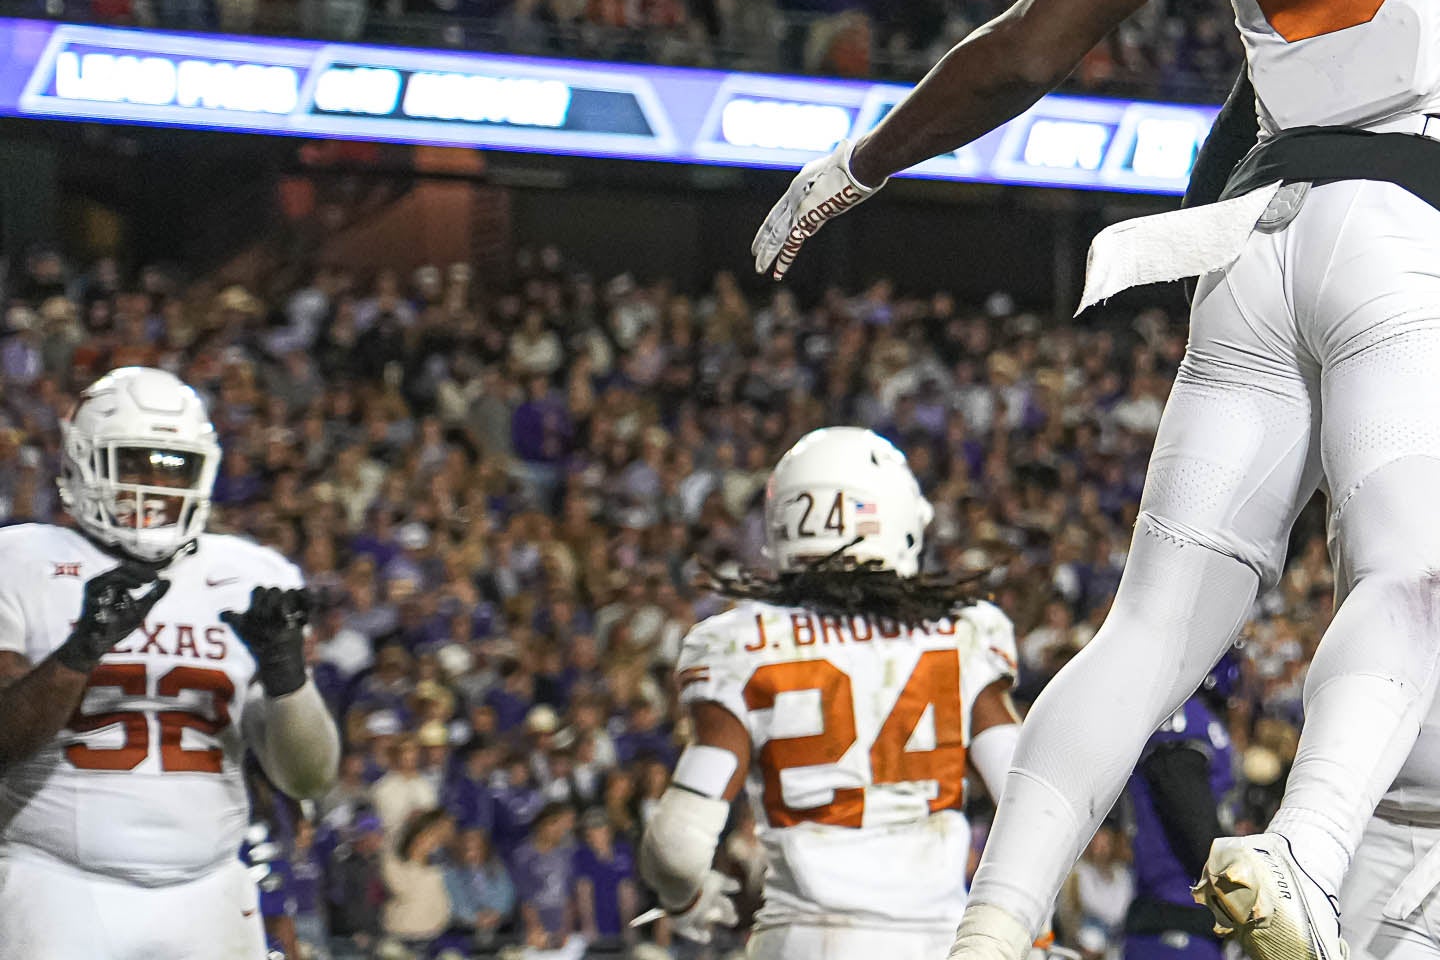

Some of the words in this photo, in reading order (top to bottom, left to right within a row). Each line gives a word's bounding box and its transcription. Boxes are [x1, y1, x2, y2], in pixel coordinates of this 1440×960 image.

[797, 492, 845, 537] 24
[745, 614, 780, 651] J.
[64, 663, 235, 774] 52
[742, 649, 966, 828] 24
